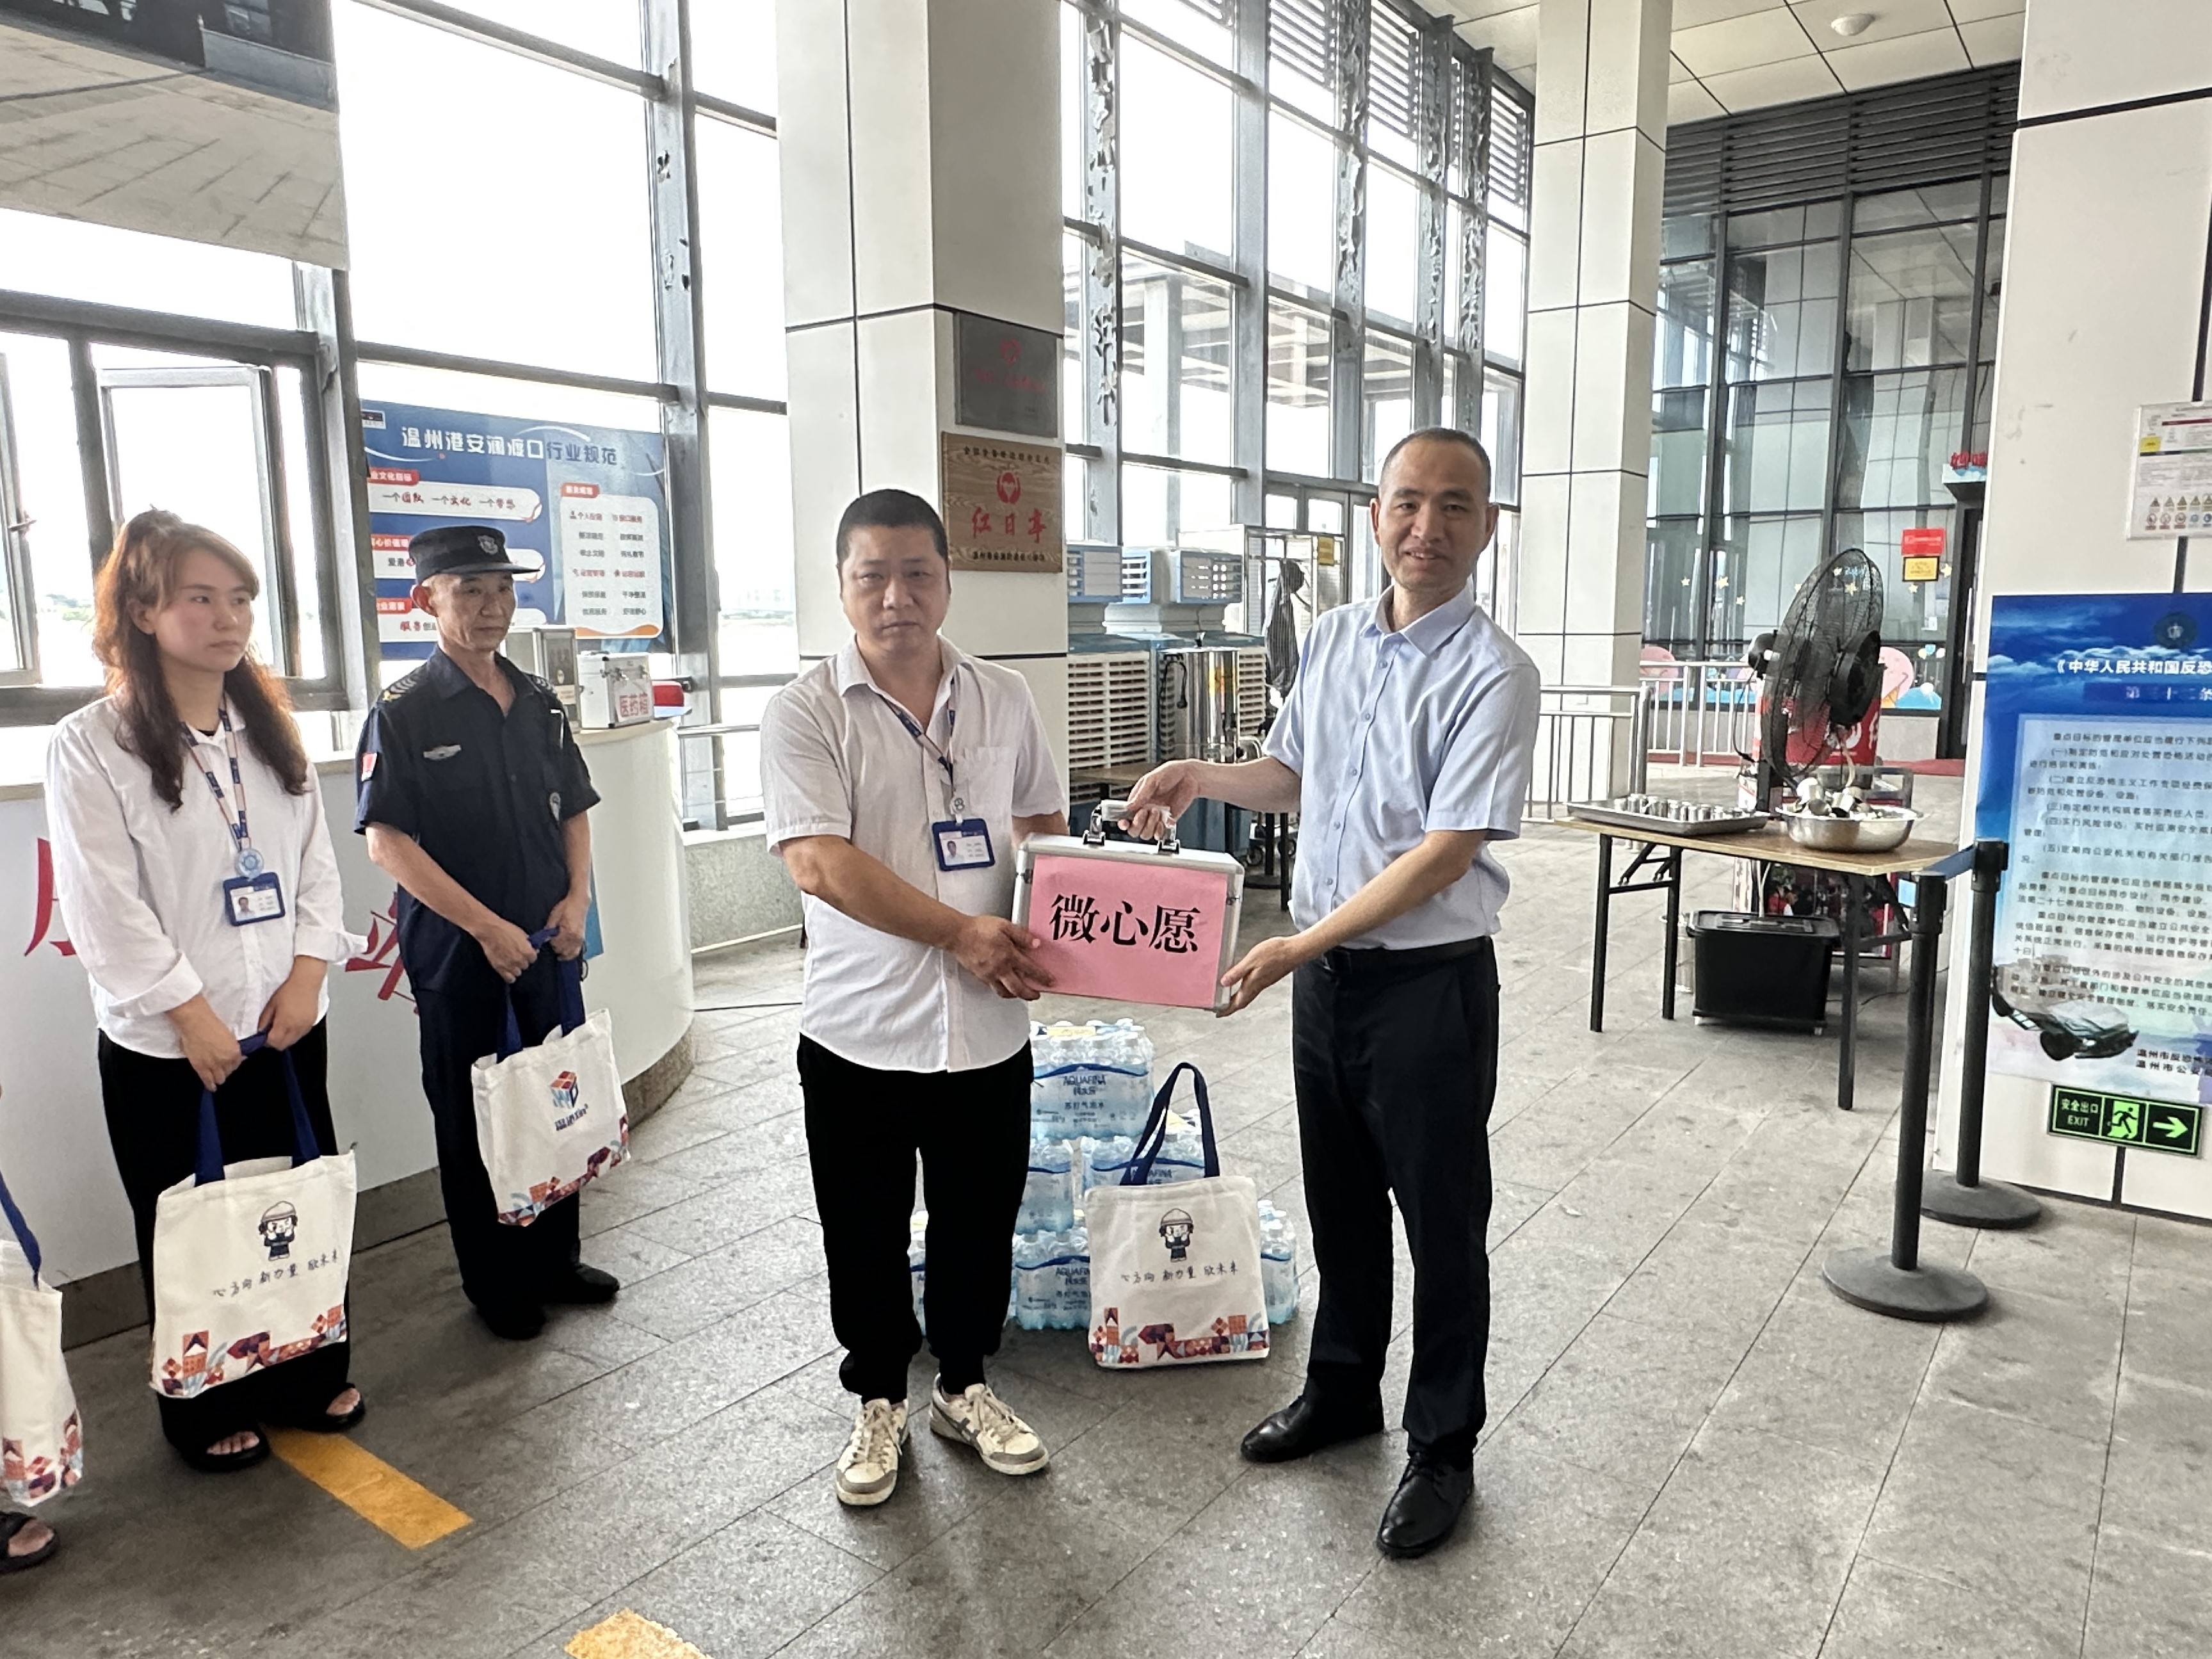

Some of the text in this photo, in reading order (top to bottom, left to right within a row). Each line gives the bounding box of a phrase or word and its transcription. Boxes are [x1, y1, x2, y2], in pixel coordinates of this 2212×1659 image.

[1049, 893, 1202, 953] 微心愿
[1063, 1075, 1106, 1085] AQUAFINA
[2062, 1099, 2099, 1113] 安全出口
[2067, 1115, 2089, 1126] EXIT
